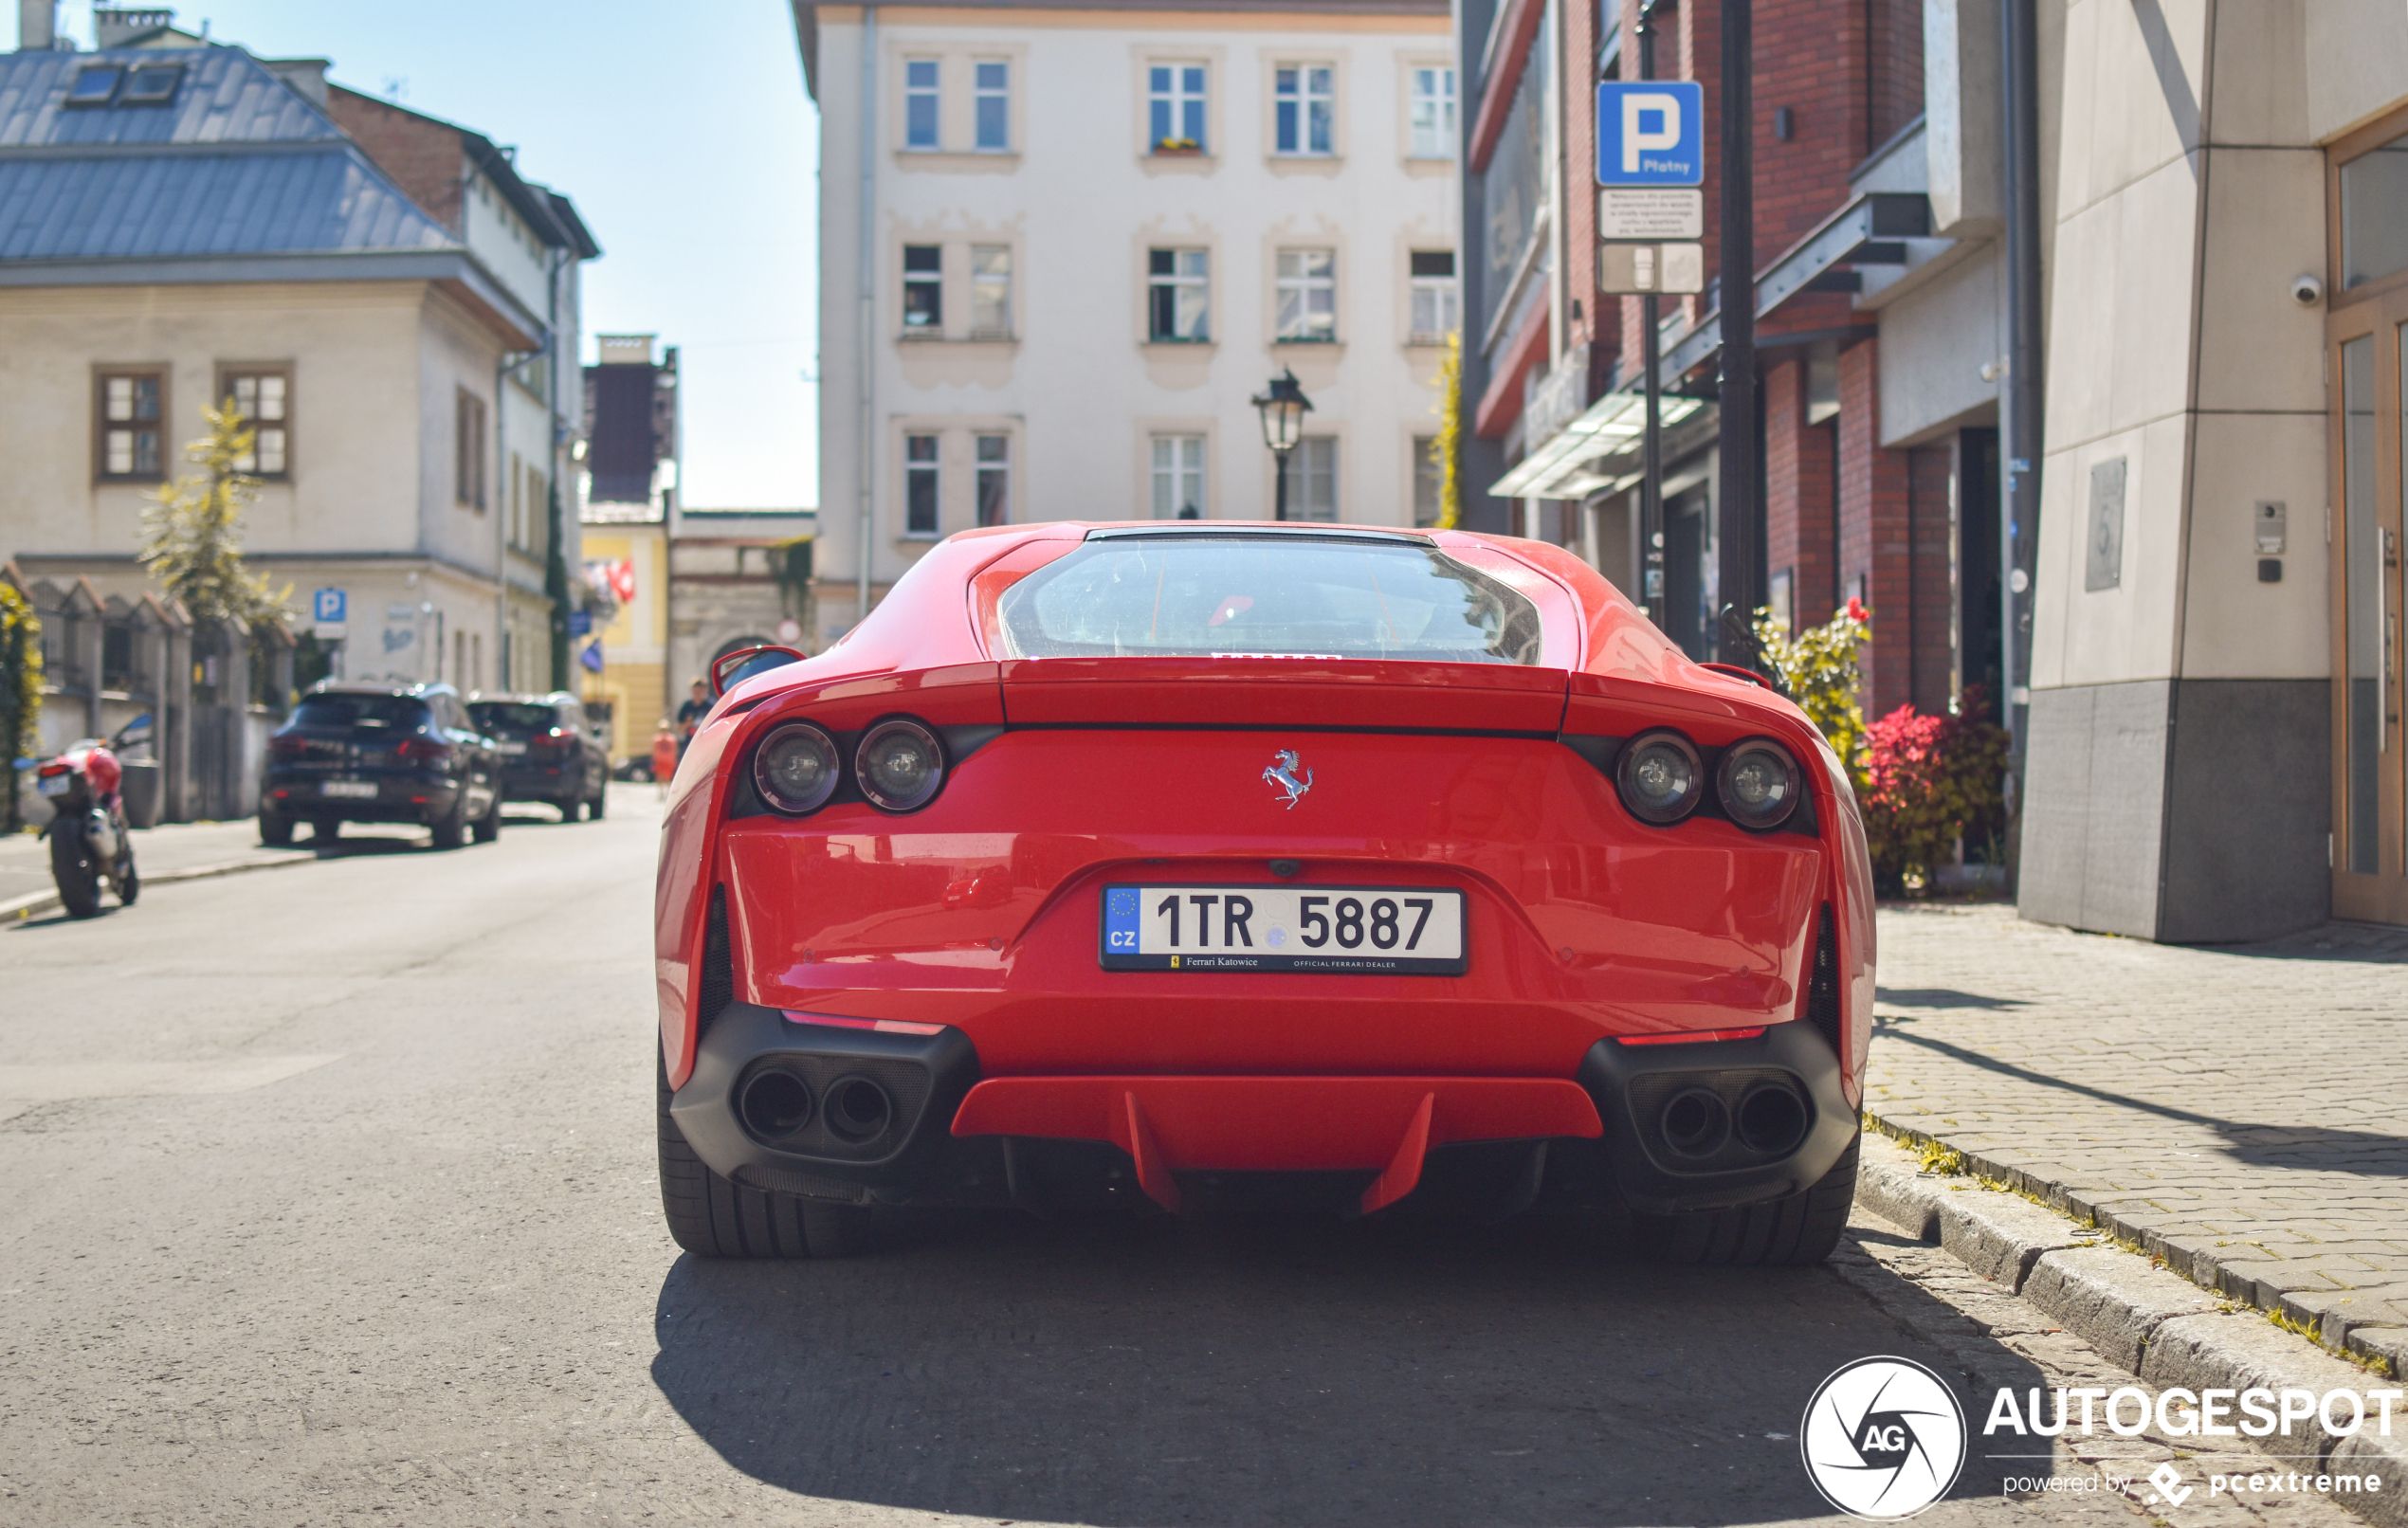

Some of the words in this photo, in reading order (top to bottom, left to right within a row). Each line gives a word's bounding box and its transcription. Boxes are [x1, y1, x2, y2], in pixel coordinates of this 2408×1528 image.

[1622, 93, 1681, 173] P
[1643, 158, 1690, 175] Płatny
[320, 593, 340, 618] P
[1158, 895, 1253, 947] 1TR
[1300, 896, 1433, 950] 5887
[1110, 931, 1135, 947] CZ
[1187, 957, 1215, 966] Ferrari
[1217, 957, 1258, 966] Katowice
